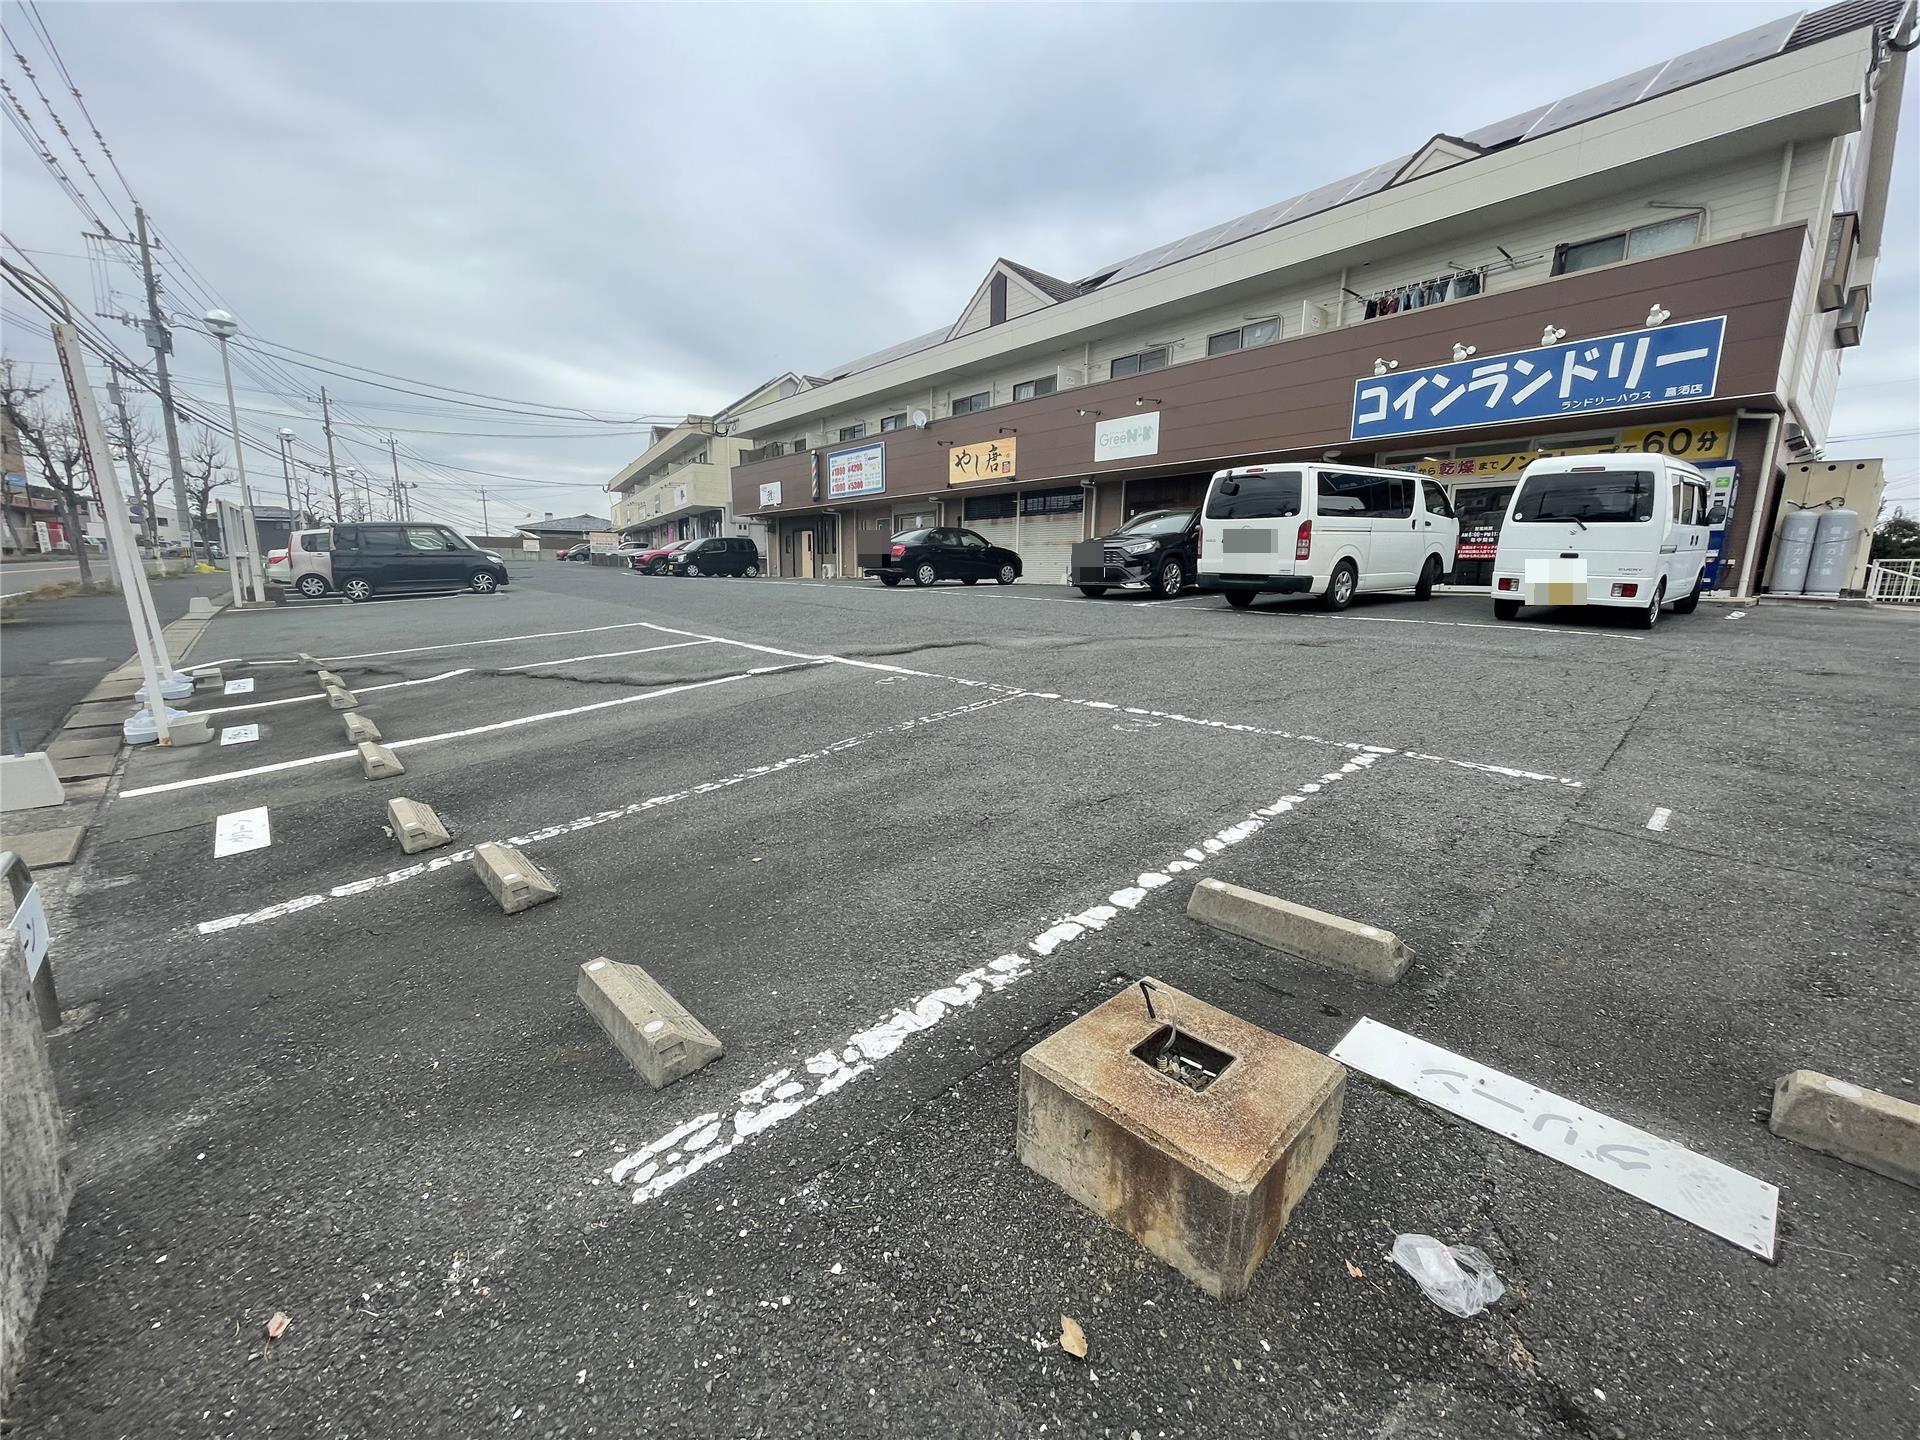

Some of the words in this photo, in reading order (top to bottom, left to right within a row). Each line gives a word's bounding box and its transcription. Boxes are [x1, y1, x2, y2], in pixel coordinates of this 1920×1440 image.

[1358, 336, 1709, 425] コインランドリー
[1561, 391, 1652, 410] ランドリーハウス
[1643, 423, 1719, 455] 60分
